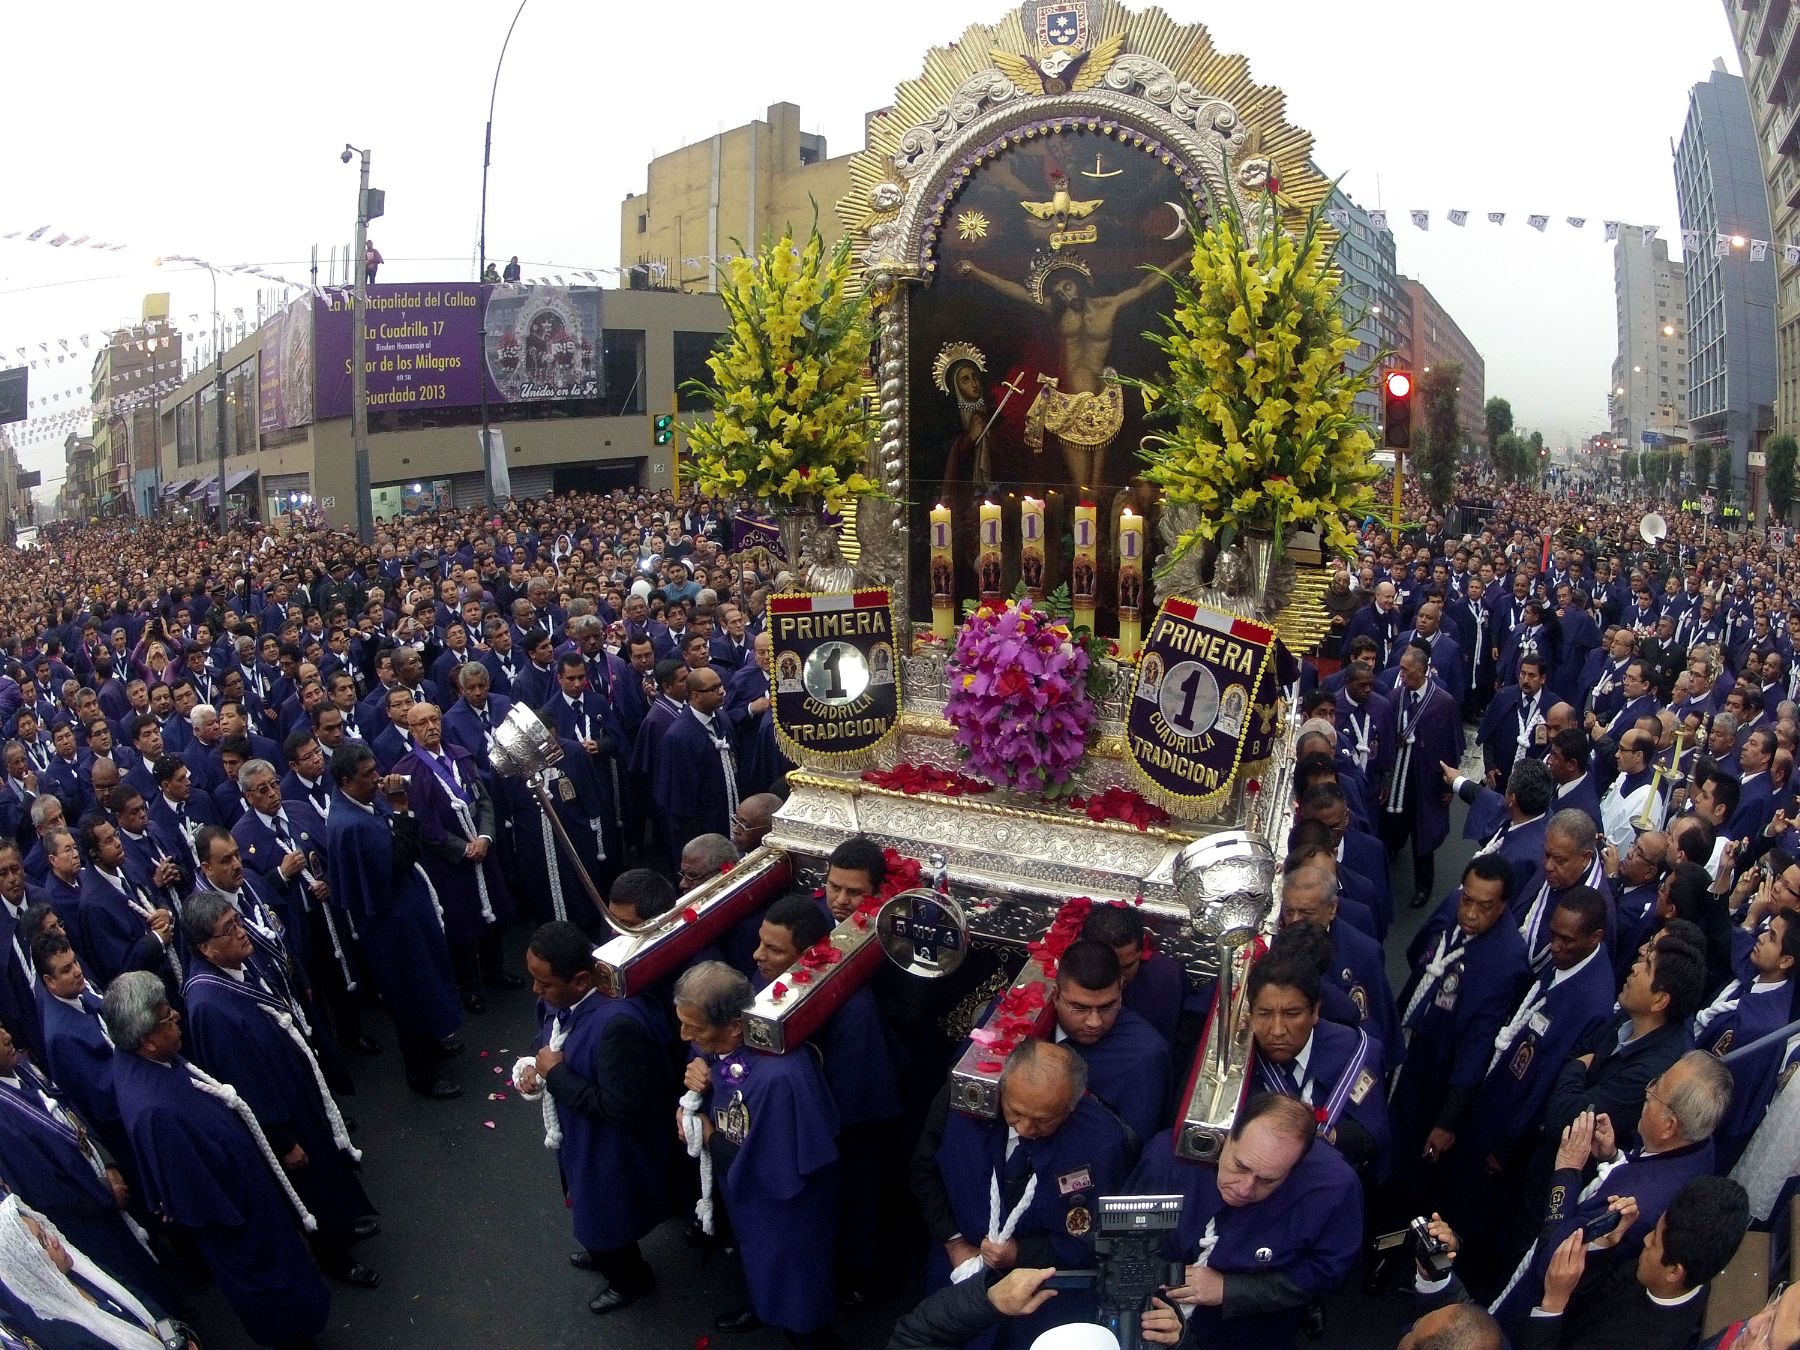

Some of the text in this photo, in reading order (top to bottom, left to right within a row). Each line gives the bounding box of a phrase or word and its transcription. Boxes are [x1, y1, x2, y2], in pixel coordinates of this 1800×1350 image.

[424, 292, 440, 308] del
[444, 291, 476, 307] Callao
[401, 311, 406, 319] y
[364, 321, 444, 340] La Cuadrilla 17
[375, 340, 432, 352] Rinden Homenaje al
[345, 353, 461, 375] Sor de los Milagros
[419, 385, 446, 401] 2013
[521, 381, 598, 398] Unidos en la Fe
[934, 523, 945, 547] 1
[987, 520, 997, 545] 1
[1025, 514, 1036, 539] 1
[1079, 520, 1090, 546] 1
[1125, 532, 1136, 557] 1
[780, 611, 886, 641] PRIMERA
[1156, 619, 1254, 676] PRIMERA
[823, 647, 847, 699] 1
[802, 693, 876, 720] CUADRILLA
[1173, 669, 1202, 731] 1
[1149, 710, 1216, 754] CUADRILLA
